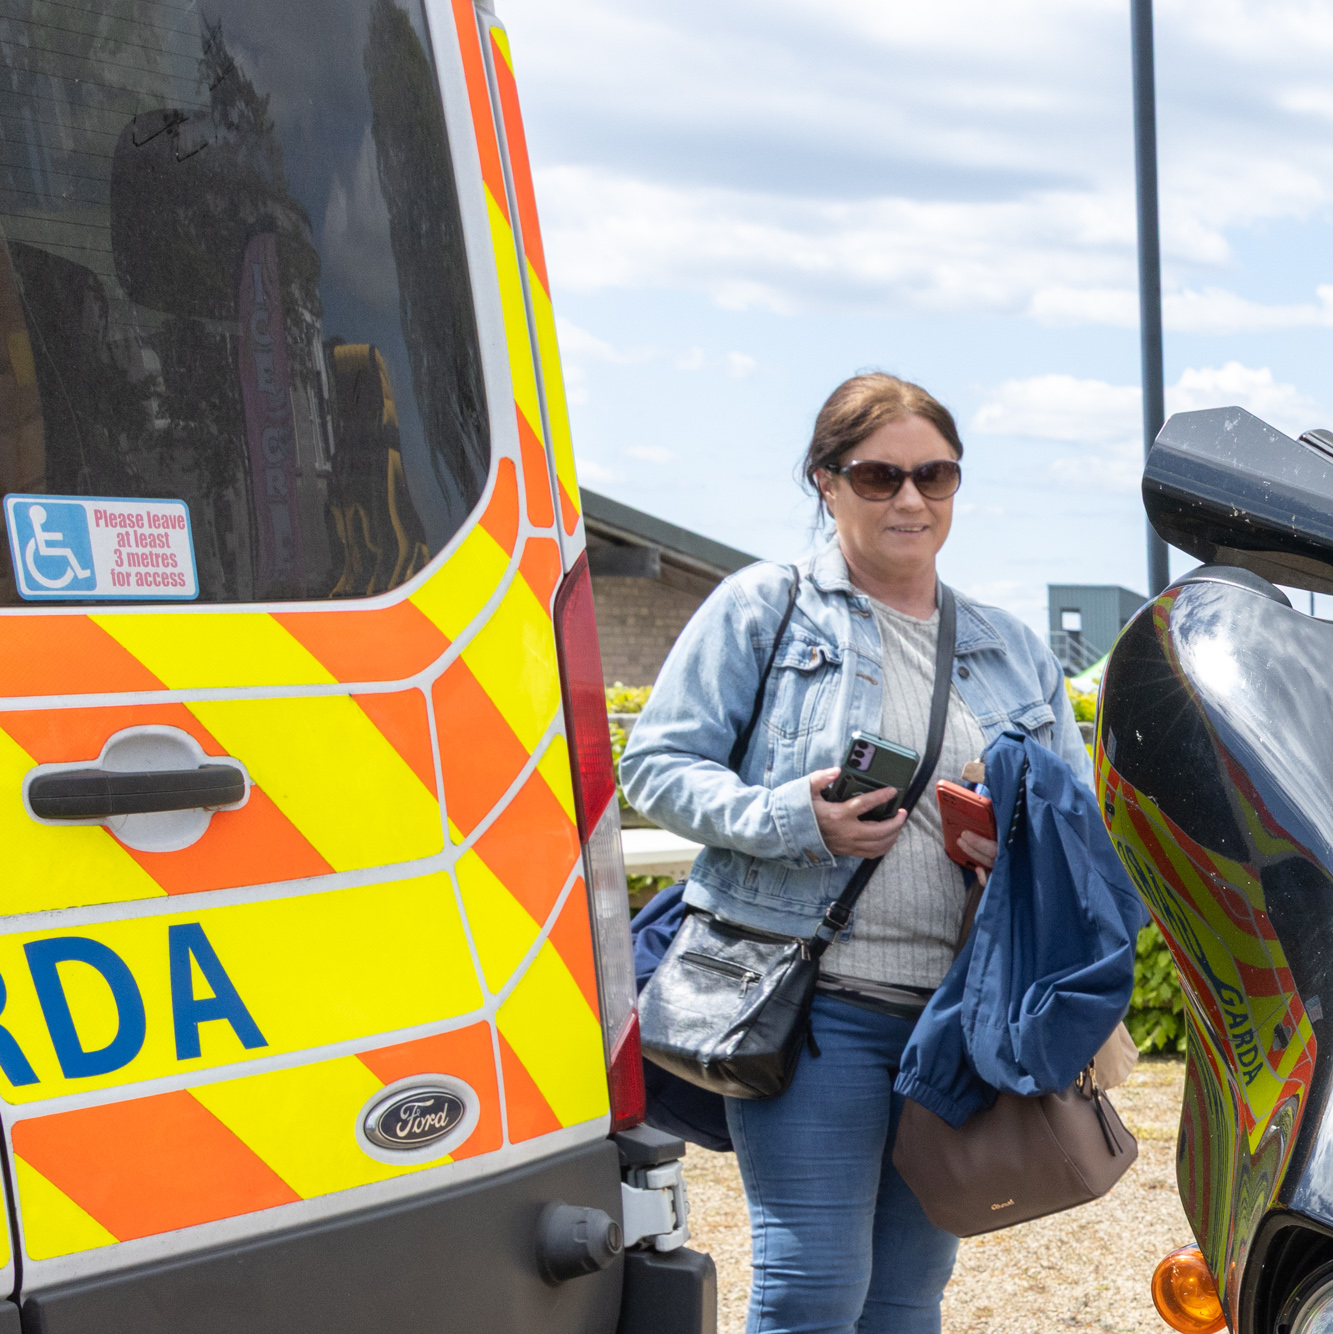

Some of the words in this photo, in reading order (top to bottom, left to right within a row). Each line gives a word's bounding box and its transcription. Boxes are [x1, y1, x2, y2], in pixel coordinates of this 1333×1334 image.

[93, 508, 144, 529] Please
[146, 511, 186, 530] leave
[116, 531, 132, 548] at
[133, 529, 171, 549] least
[113, 548, 124, 568] 3
[127, 550, 178, 568] metres
[110, 568, 132, 587] for
[135, 570, 186, 588] access
[396, 1099, 449, 1138] Ford
